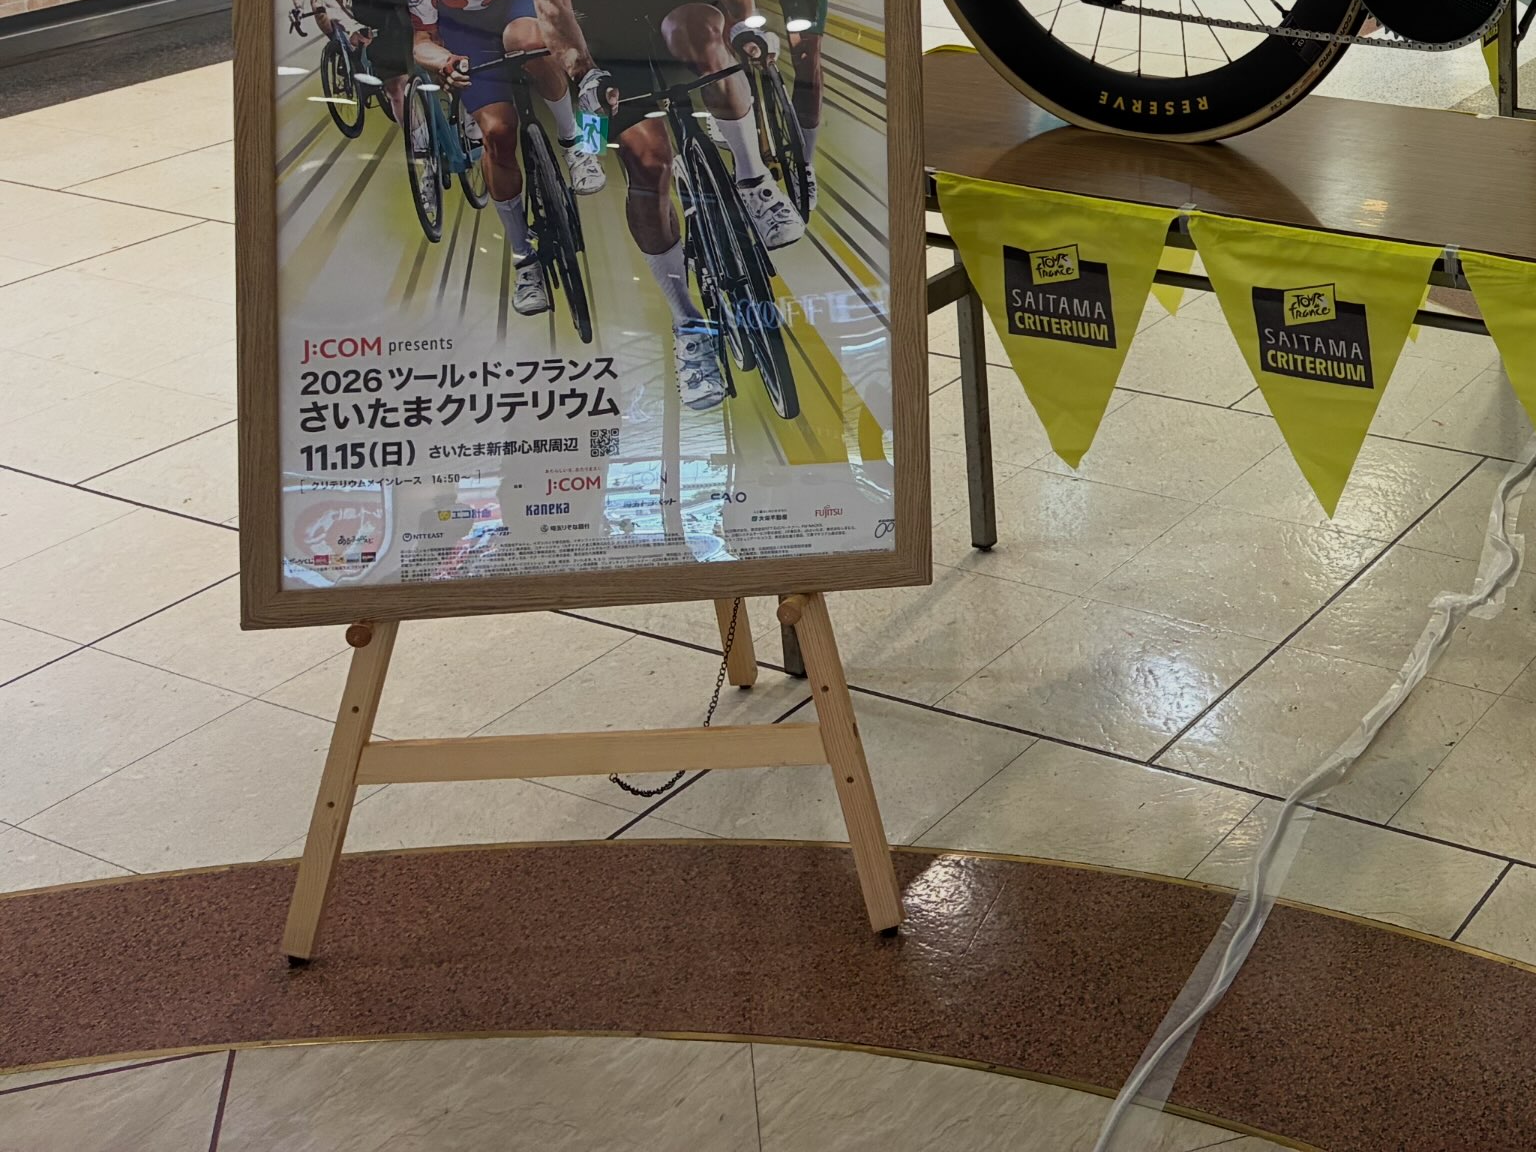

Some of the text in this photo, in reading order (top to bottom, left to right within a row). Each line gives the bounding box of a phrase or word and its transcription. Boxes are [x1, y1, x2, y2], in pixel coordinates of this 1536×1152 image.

[1097, 89, 1210, 117] RESERVE
[1035, 262, 1074, 279] france
[1011, 288, 1107, 321] SAITAMA
[1288, 303, 1331, 320] france
[1014, 311, 1110, 343] CRITERIUM
[301, 336, 454, 364] J:COM presents
[1264, 327, 1365, 361] SAITAMA
[300, 356, 619, 396] 2026ツール・ド・フランス
[1267, 350, 1367, 383] CRITERIUM
[299, 386, 621, 433] さいたまクリテリウム
[428, 437, 579, 460] さいたま新都心駅周辺
[311, 475, 423, 491] クリテリウムメインレース
[545, 475, 602, 496] J:COM
[814, 505, 844, 518] FUJITSU
[428, 532, 444, 540] EAST
